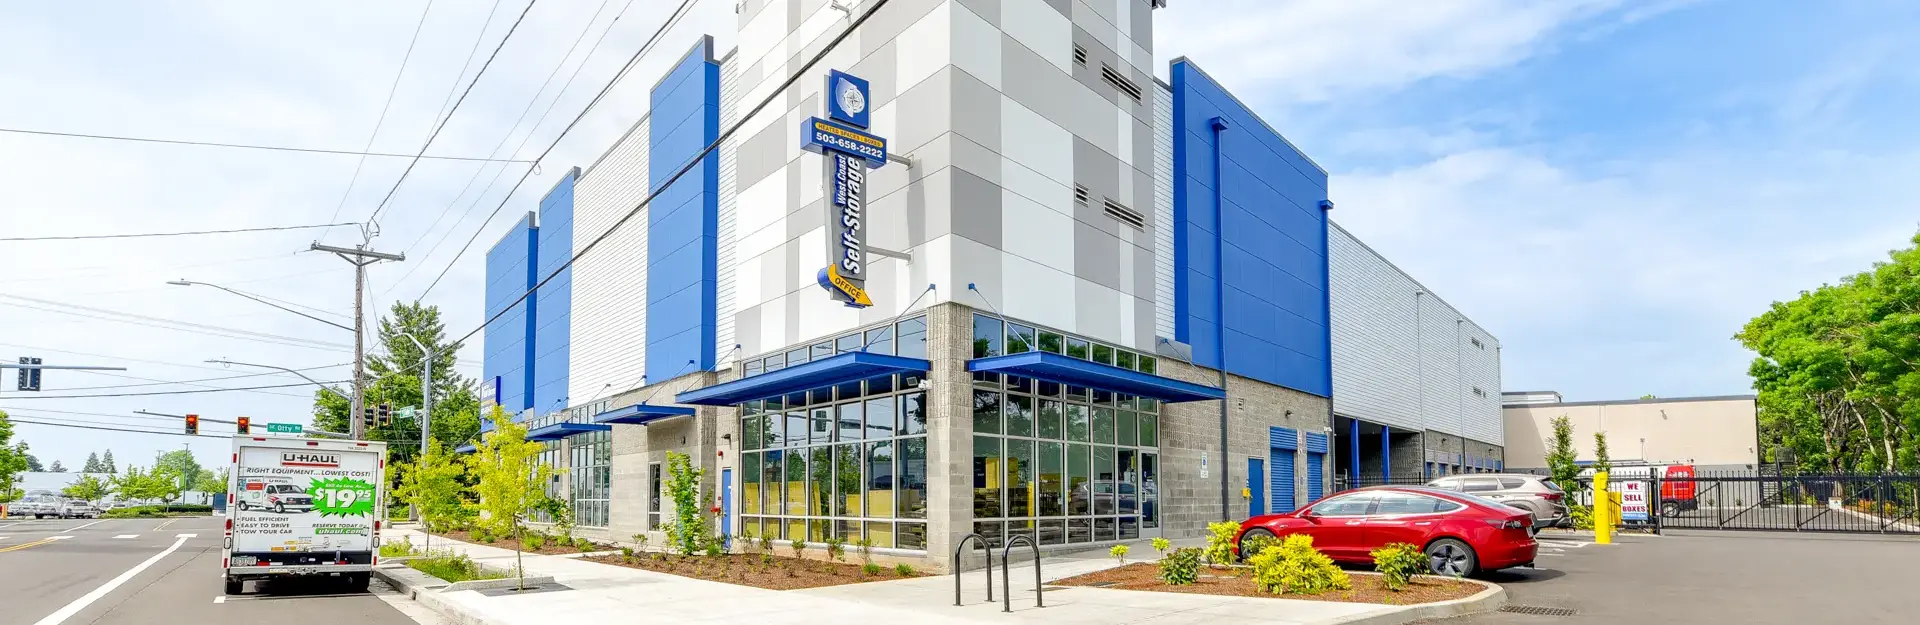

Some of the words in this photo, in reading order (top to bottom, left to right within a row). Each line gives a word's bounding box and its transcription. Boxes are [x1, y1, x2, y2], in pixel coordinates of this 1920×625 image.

[816, 131, 883, 158] 503-658-2222
[818, 124, 840, 134] HEATED
[840, 130, 859, 140] SPACES
[864, 137, 881, 146] BOXES
[837, 155, 846, 181] Coast
[837, 181, 846, 205] West
[843, 156, 864, 274] Self-Storage
[835, 277, 861, 299] OFFICE
[278, 425, 293, 433] Otty
[283, 453, 338, 463] U-HAUL
[1626, 482, 1639, 490] WE
